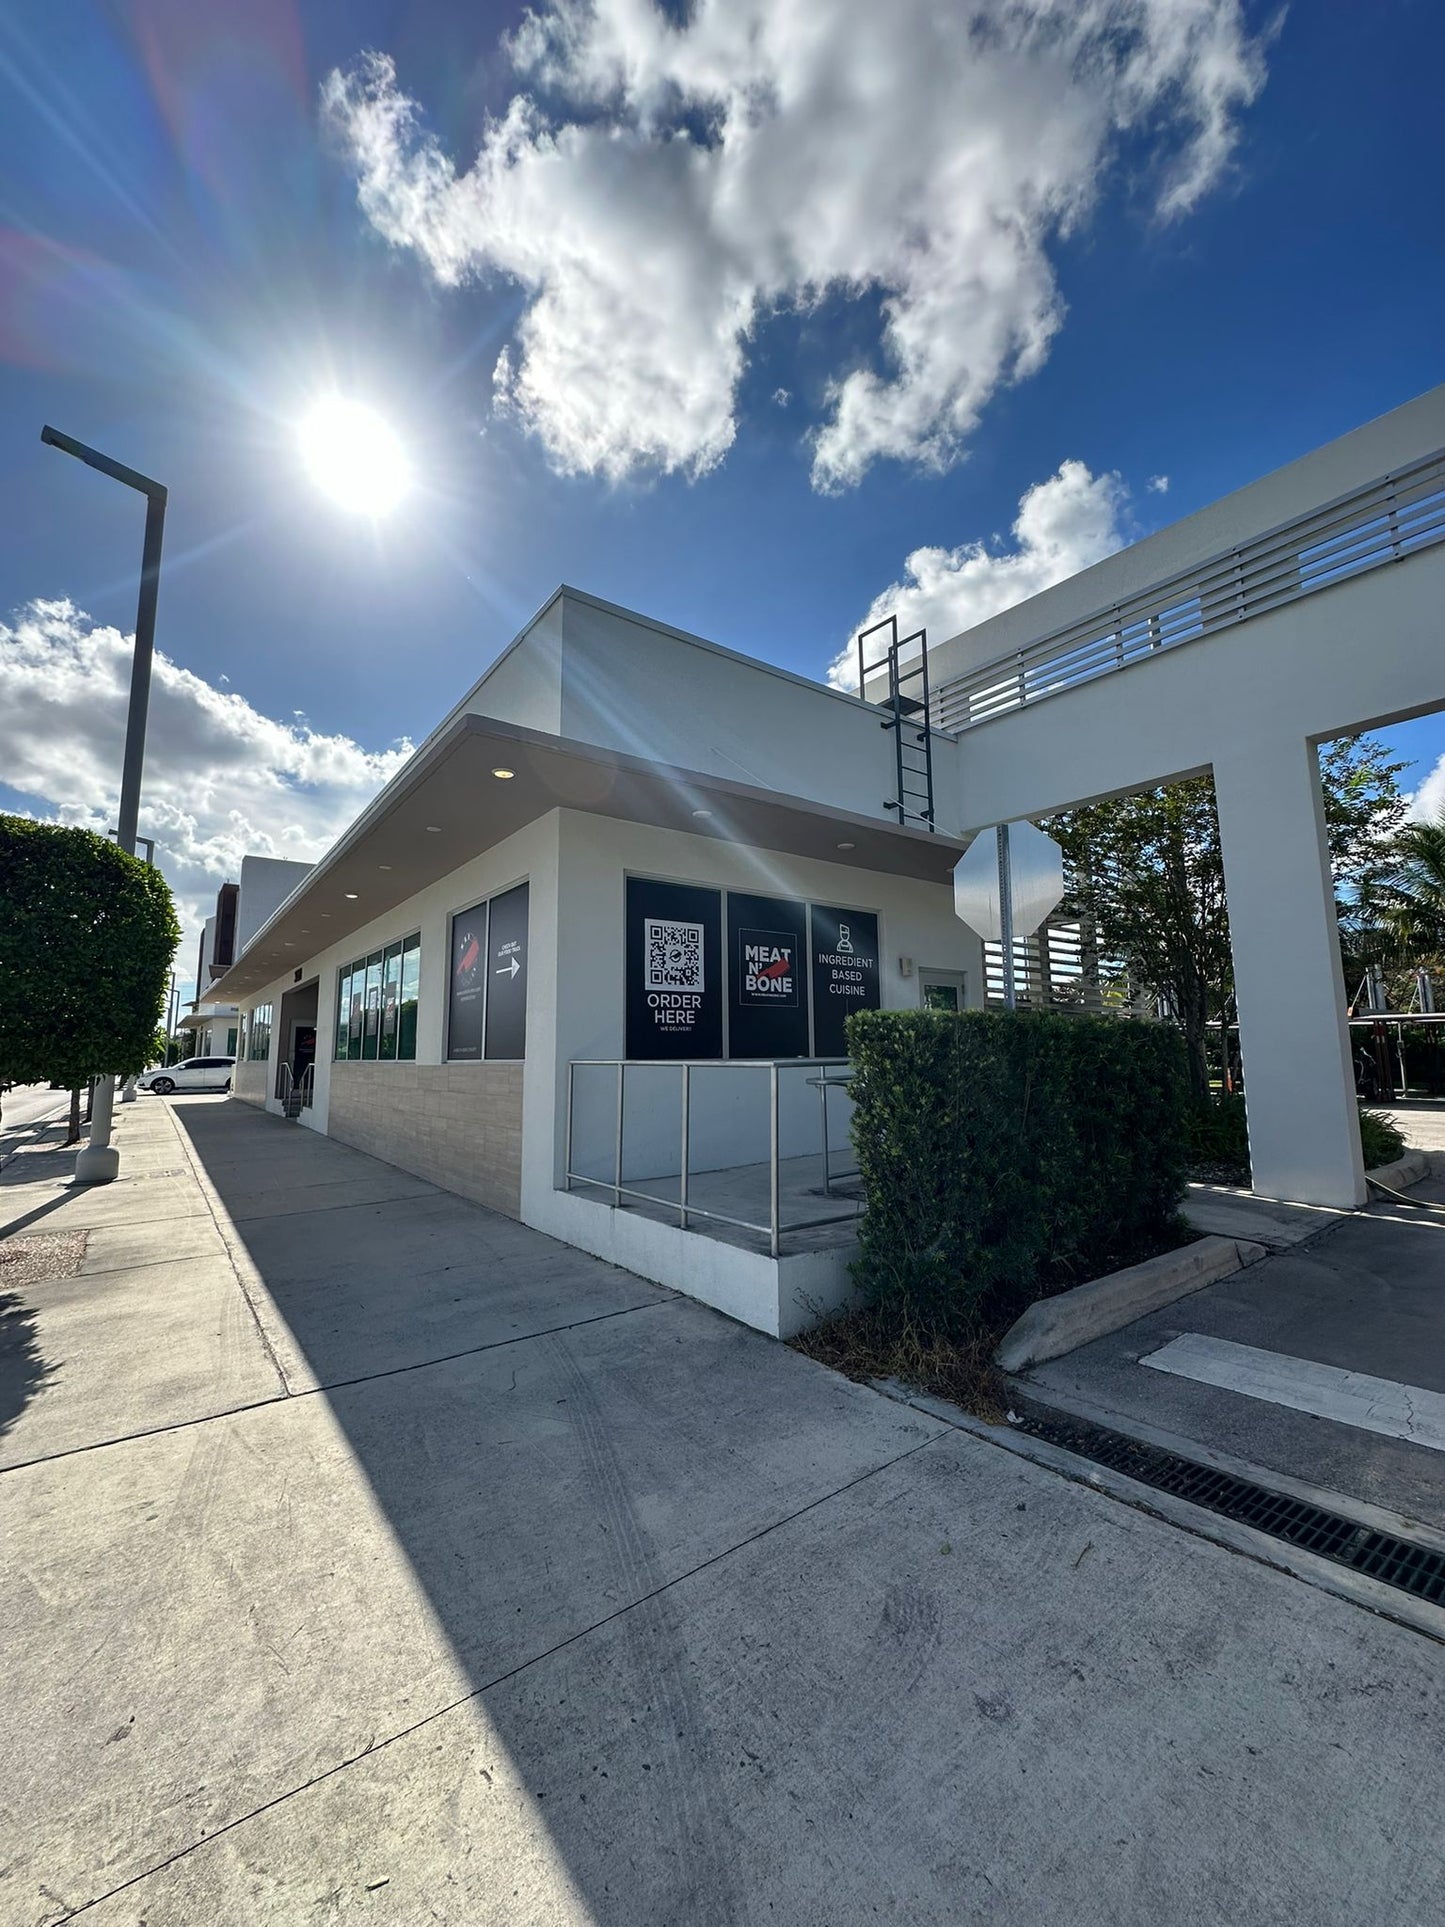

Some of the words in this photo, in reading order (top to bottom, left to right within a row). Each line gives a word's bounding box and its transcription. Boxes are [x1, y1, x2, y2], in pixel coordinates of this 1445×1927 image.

[745, 944, 791, 963] MEAT
[818, 953, 873, 968] INGREDIENT
[831, 969, 862, 981] BASED
[745, 974, 792, 993] BONE
[829, 983, 865, 996] CUISINE
[647, 993, 701, 1008] ORDER
[654, 1009, 695, 1024] HERE
